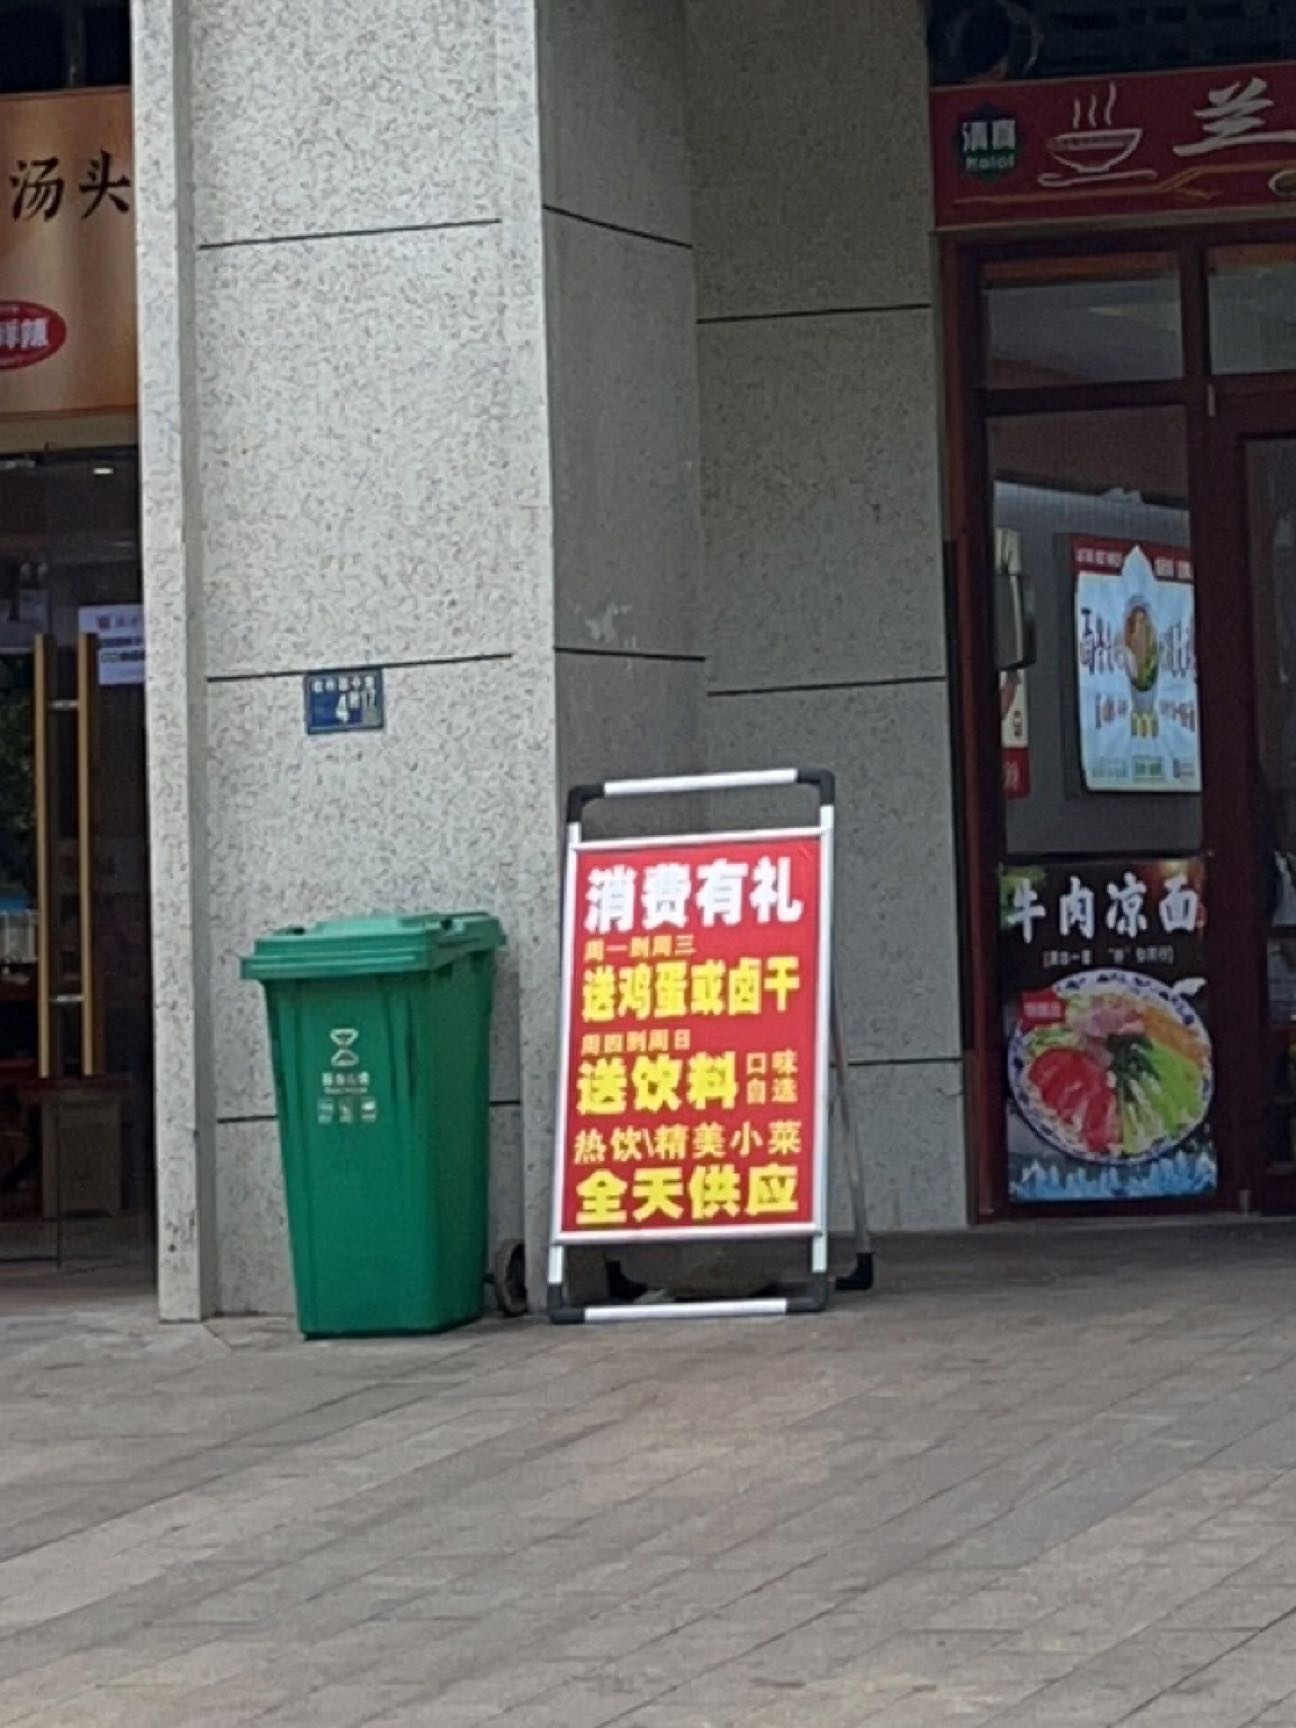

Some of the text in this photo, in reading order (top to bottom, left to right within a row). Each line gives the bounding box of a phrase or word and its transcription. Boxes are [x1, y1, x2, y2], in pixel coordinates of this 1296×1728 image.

[9, 149, 131, 221] 汤头
[583, 856, 805, 935] 消费有礼
[1006, 871, 1199, 945] 牛肉凉面
[581, 955, 801, 1023] 送鸡蛋或卤干
[576, 1050, 741, 1116] 送饮料
[746, 1048, 799, 1075] 口味
[576, 1161, 800, 1225] 全天供应
